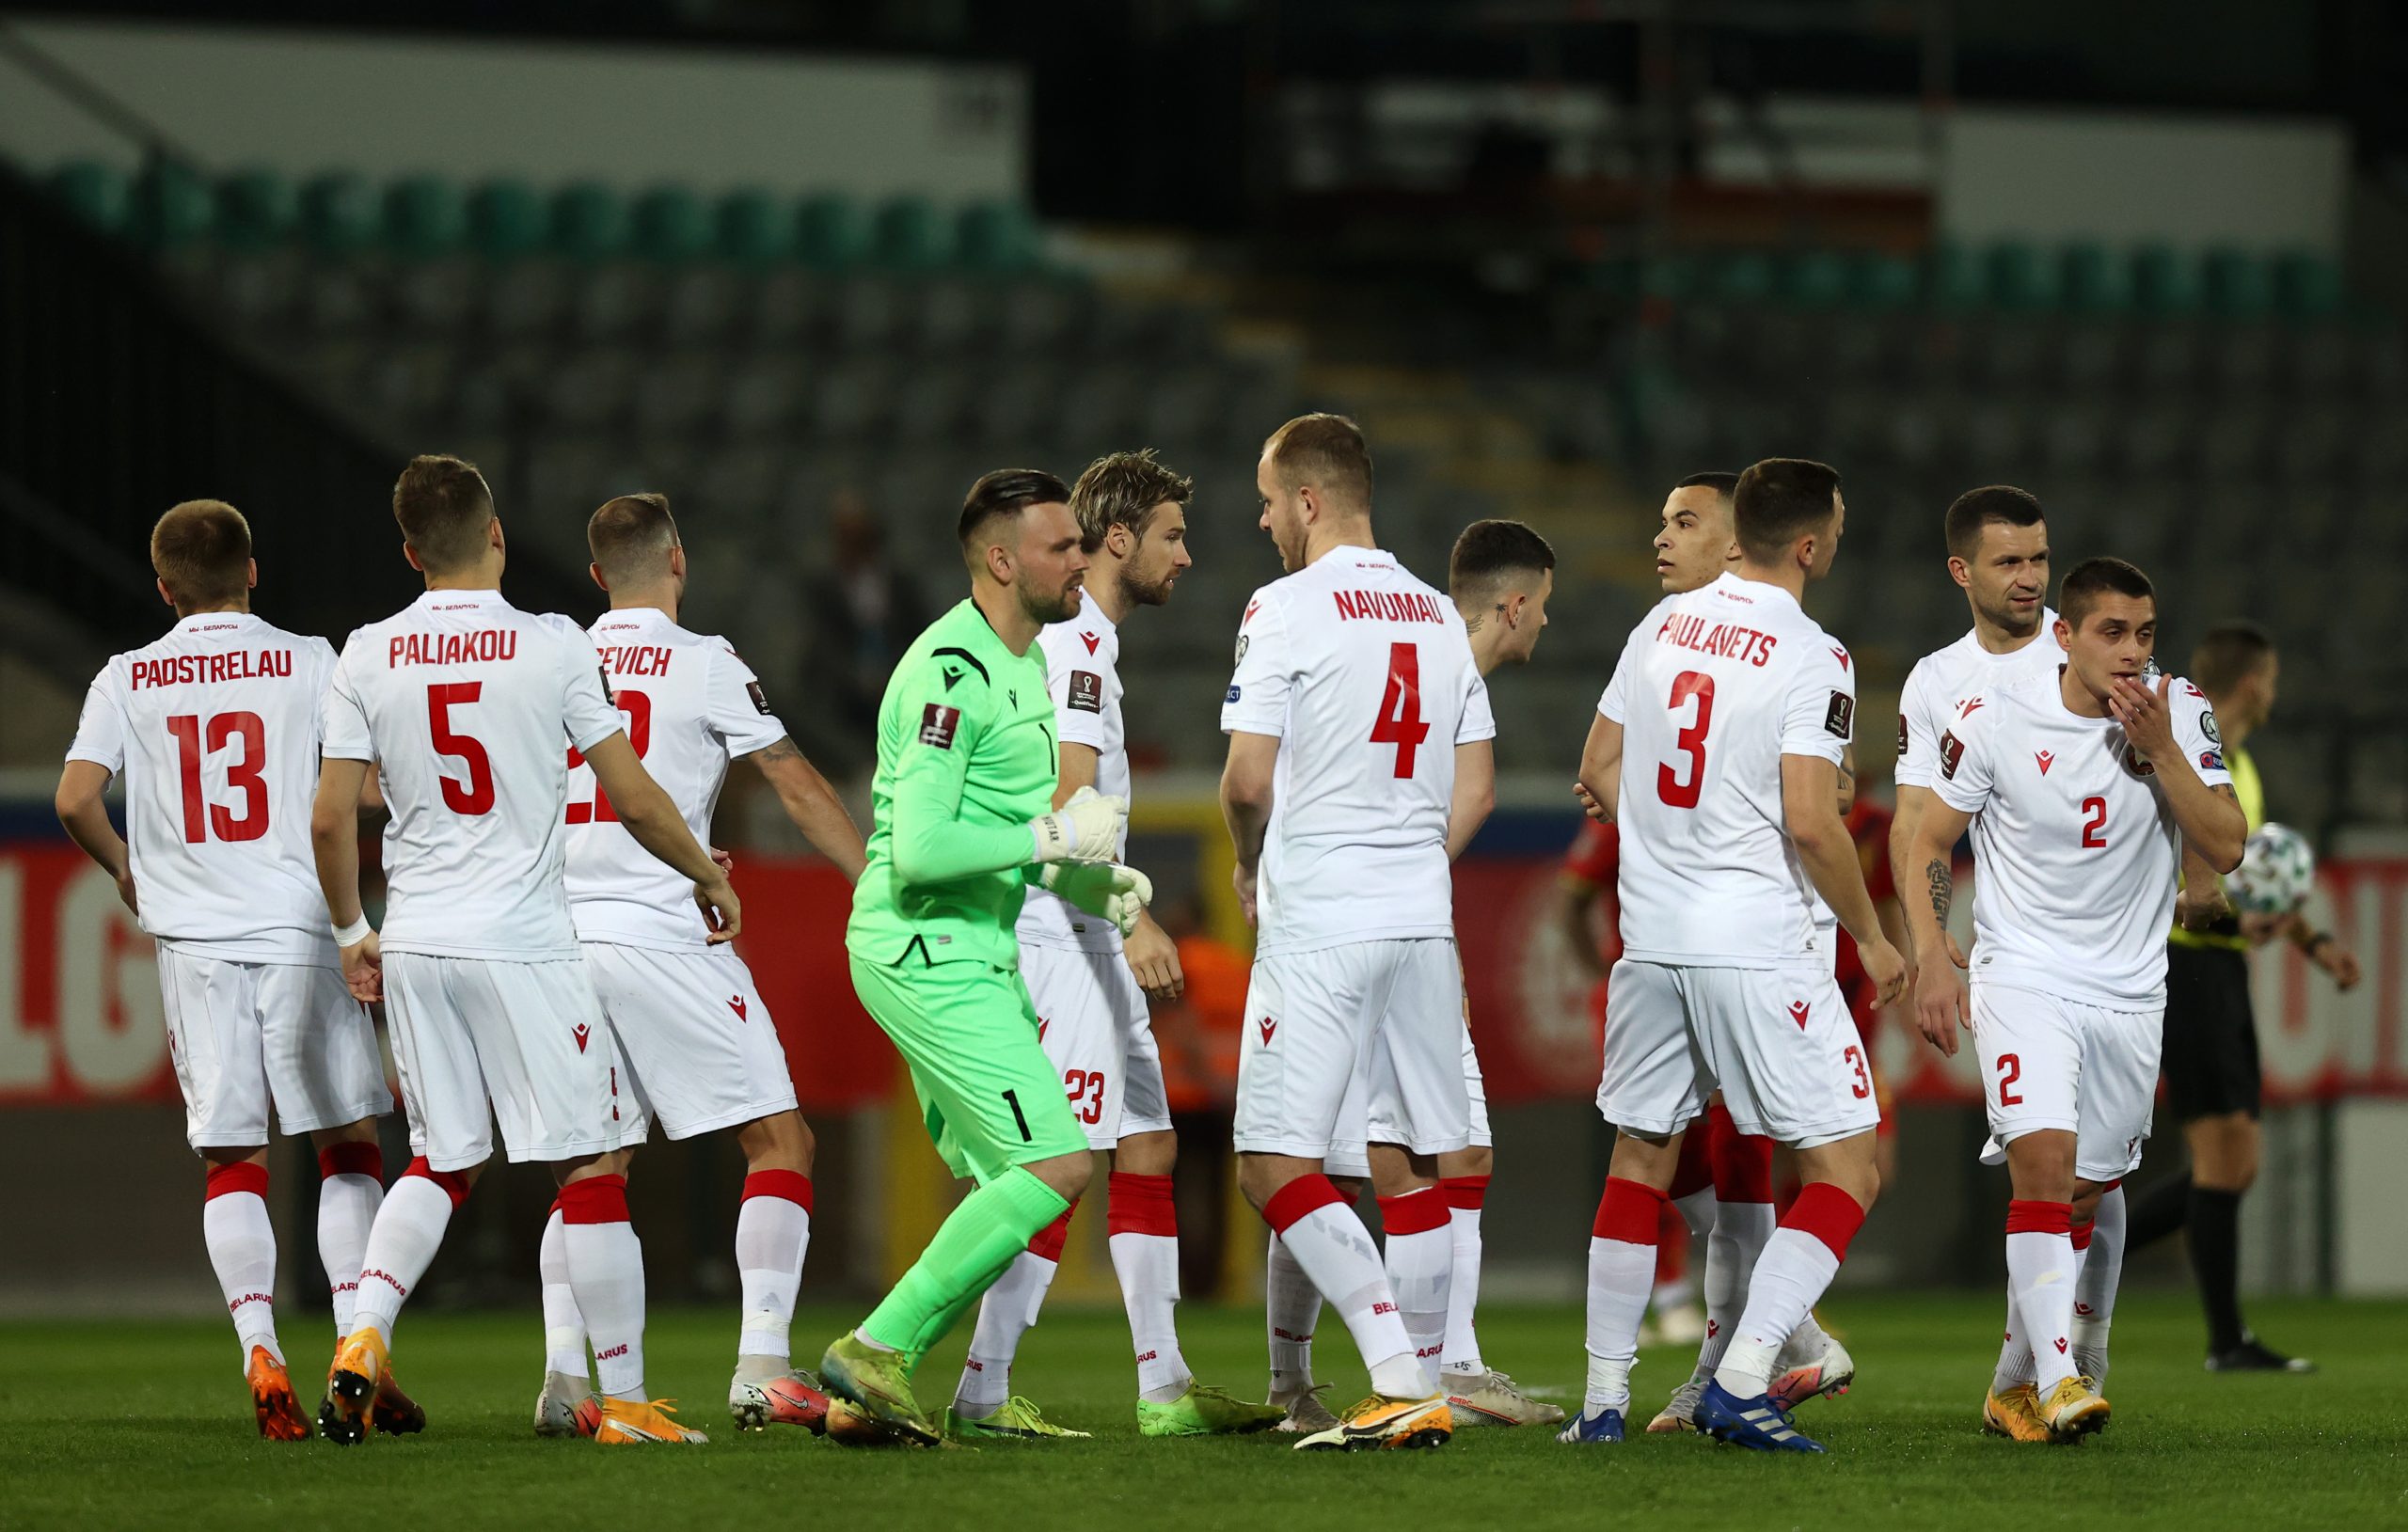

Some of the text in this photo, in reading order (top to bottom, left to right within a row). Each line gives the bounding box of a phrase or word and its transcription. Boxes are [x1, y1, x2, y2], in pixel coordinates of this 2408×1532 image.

[1333, 590, 1444, 624] NAVUMAU
[389, 629, 516, 669] PALIAKOU
[1656, 613, 1777, 667] PAULAVETS
[132, 650, 292, 690] PADSTRELAU
[1369, 642, 1431, 779] 4
[427, 681, 495, 815] 5
[1038, 722, 1055, 776] 1
[1657, 671, 1715, 809] 3
[166, 711, 269, 844] 13
[2082, 797, 2107, 848] 2
[1064, 1069, 1104, 1125] 23
[1844, 1045, 1869, 1098] 3
[1997, 1053, 2022, 1107] 2
[1001, 1088, 1033, 1143] 1
[230, 1292, 273, 1312] BELARUS
[595, 1344, 627, 1360] ARUS
